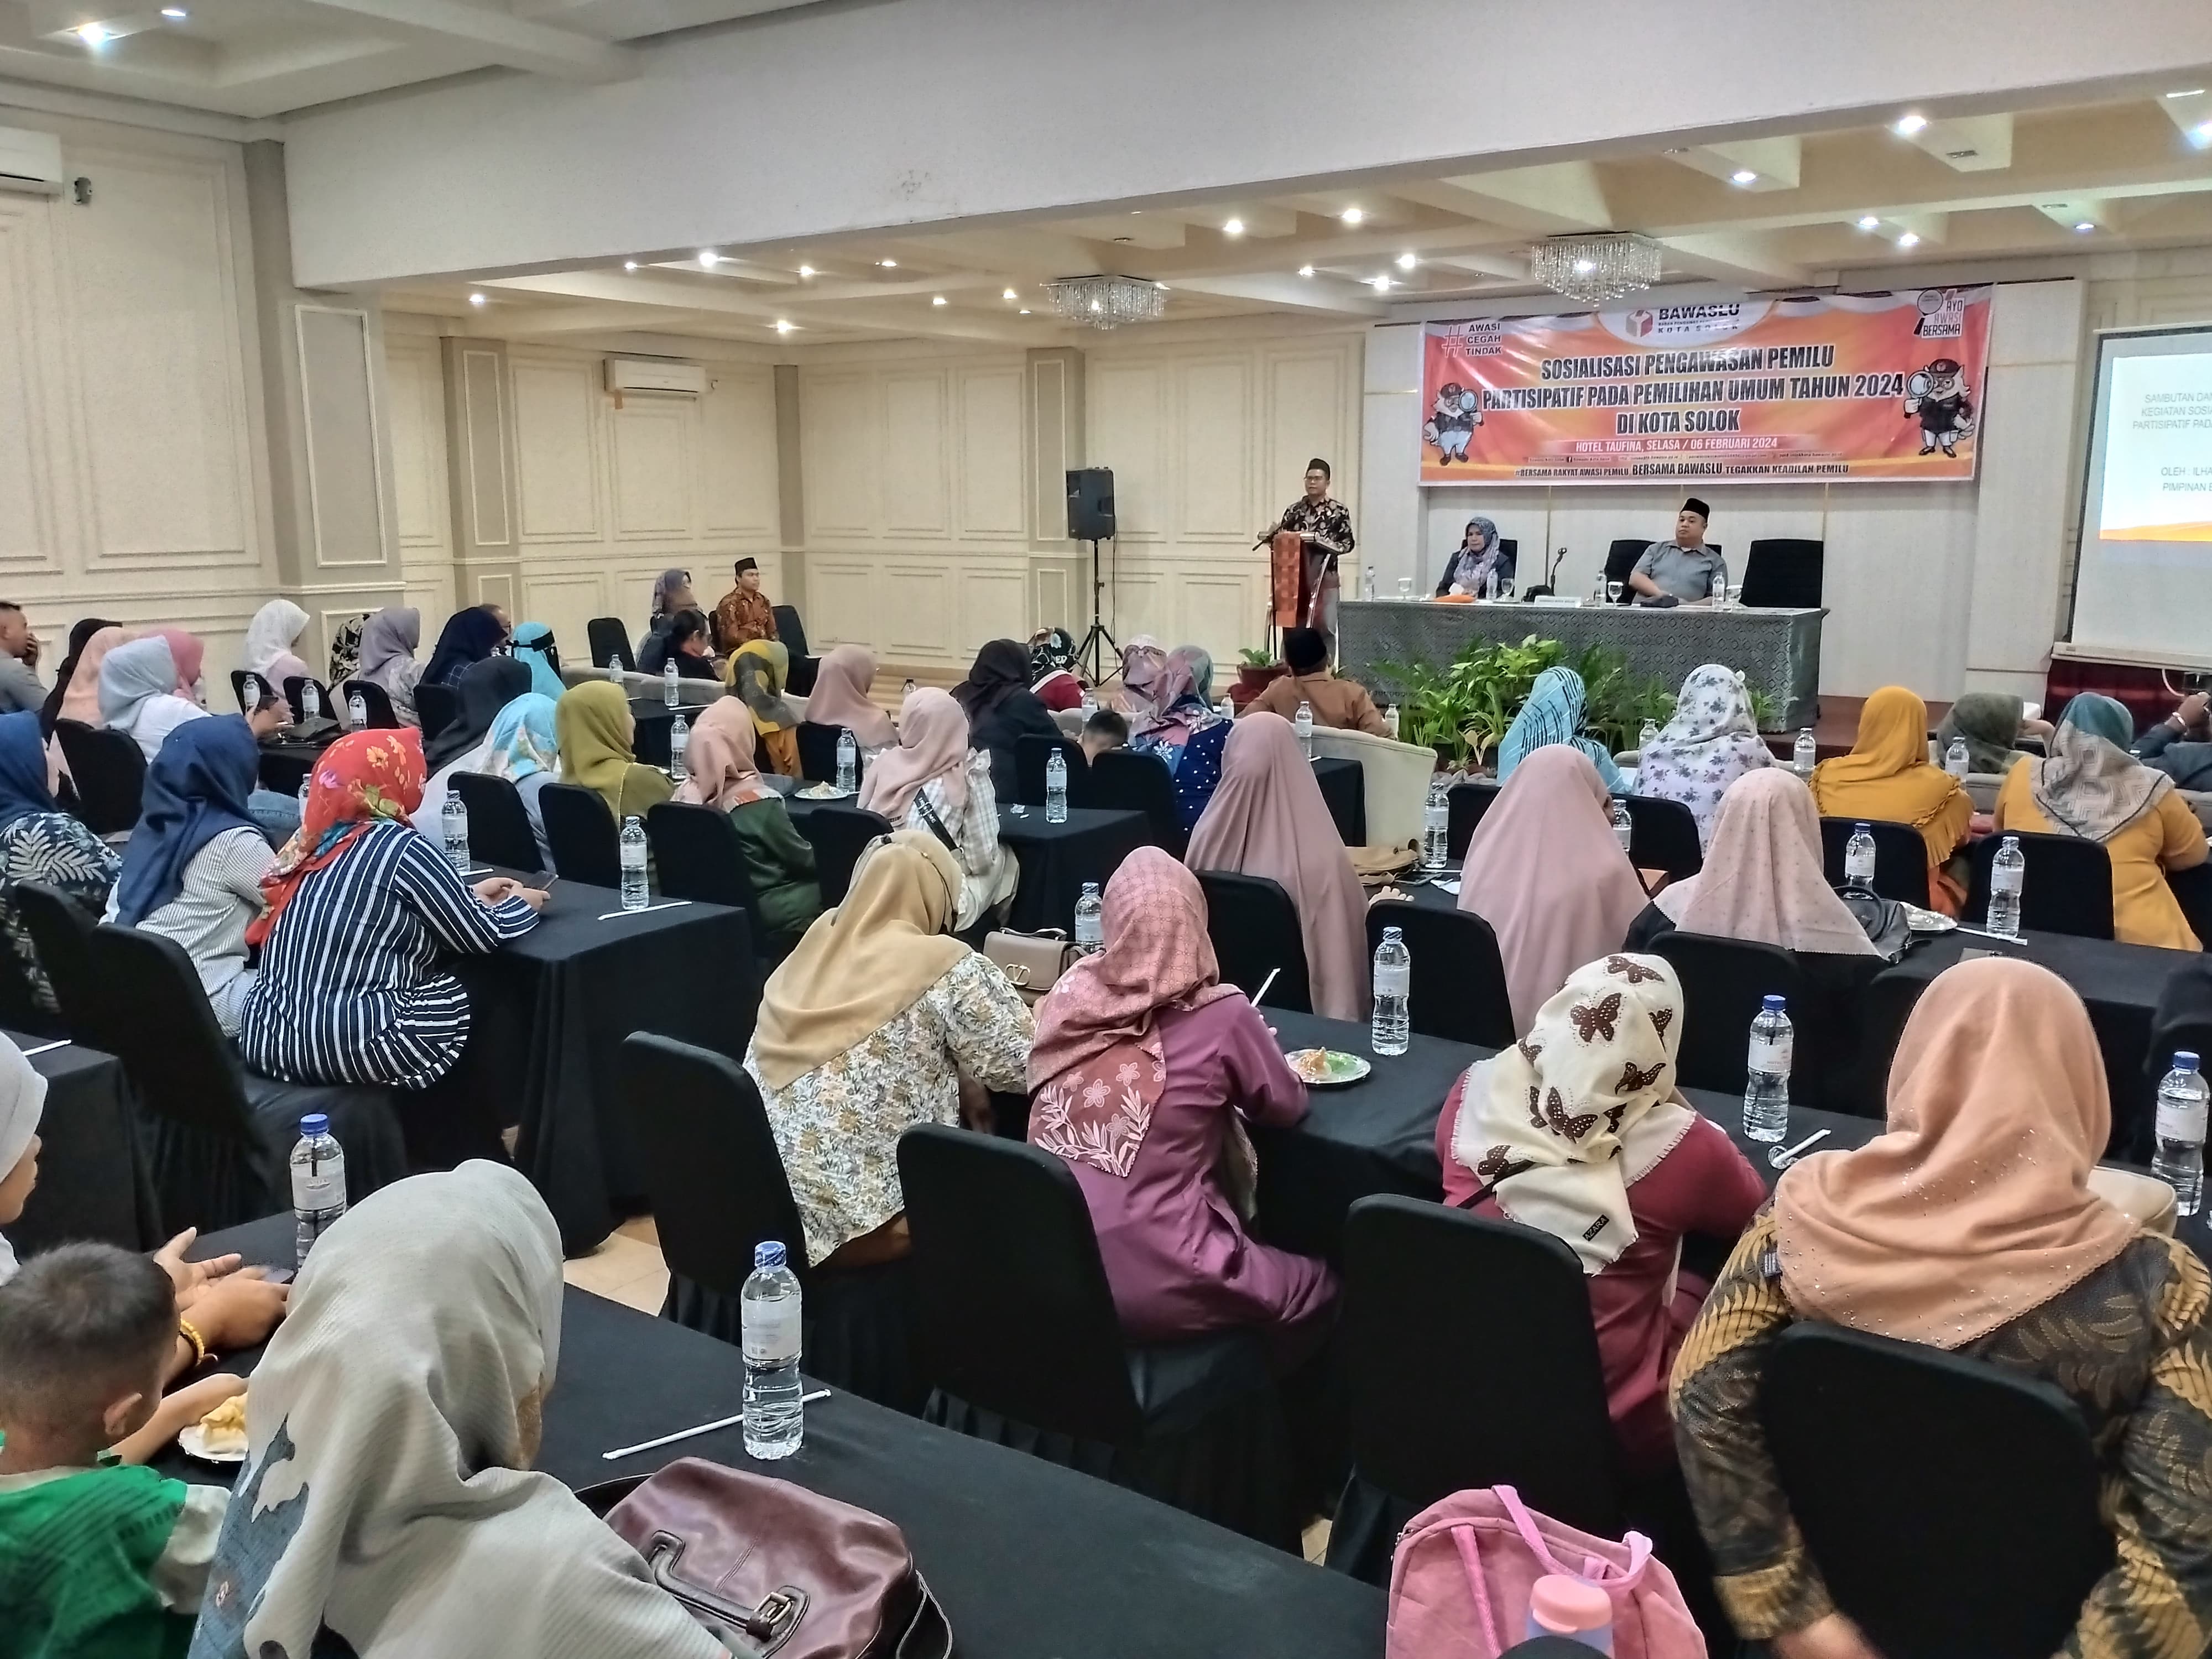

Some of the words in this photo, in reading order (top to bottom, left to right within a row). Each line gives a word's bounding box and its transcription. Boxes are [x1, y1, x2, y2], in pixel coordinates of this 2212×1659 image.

[1947, 300, 1963, 311] AYO
[1659, 304, 1740, 320] BAWASLU
[1934, 313, 1961, 324] AWASI
[1469, 323, 1500, 332] AWASI
[1923, 324, 1960, 336] BERSAMA
[1468, 335, 1501, 343] CEGAH
[1465, 347, 1502, 355] TINDAK
[1541, 356, 1640, 379] SOSIALISASI
[1645, 347, 1762, 375] PENGAWASAN
[1767, 346, 1834, 369] PEMILU
[1483, 388, 1584, 410] PARTISIPATIF
[1588, 385, 1629, 406] PADA
[1633, 379, 1724, 405] PEMILIHAN
[1729, 377, 1785, 401] UMUM
[1790, 375, 1851, 399] TAHUN
[1855, 373, 1905, 397] 2024
[2145, 393, 2194, 403] SAMBUTAN
[2141, 406, 2187, 416] KEGIATAN
[1617, 414, 1634, 435] DI
[1639, 411, 1681, 435] KOTA
[1685, 409, 1740, 433] SOLOK
[2133, 420, 2190, 430] PARTISIPATIF
[2193, 419, 2212, 429] PAD
[1576, 442, 1603, 452] HOTEL
[1606, 440, 1644, 452] TAUFINA,
[1647, 439, 1679, 451] SELASA
[1691, 439, 1703, 450] 06
[1705, 437, 1750, 449] FEBRUARI
[1752, 437, 1778, 448] 2024
[1553, 468, 1578, 477] RAKYAT
[1604, 468, 1629, 476] PEMILU
[1632, 463, 1676, 476] BERSAMA
[1677, 462, 1723, 474] BAWASLU
[1725, 466, 1770, 474] TEGAKKAN
[1772, 465, 1814, 474] KEADILAN
[1816, 465, 1849, 473] PEMILU
[2161, 467, 2185, 476] OLEH
[2162, 482, 2206, 492] PIMPINAN
[1585, 1217, 1607, 1240] AZARA
